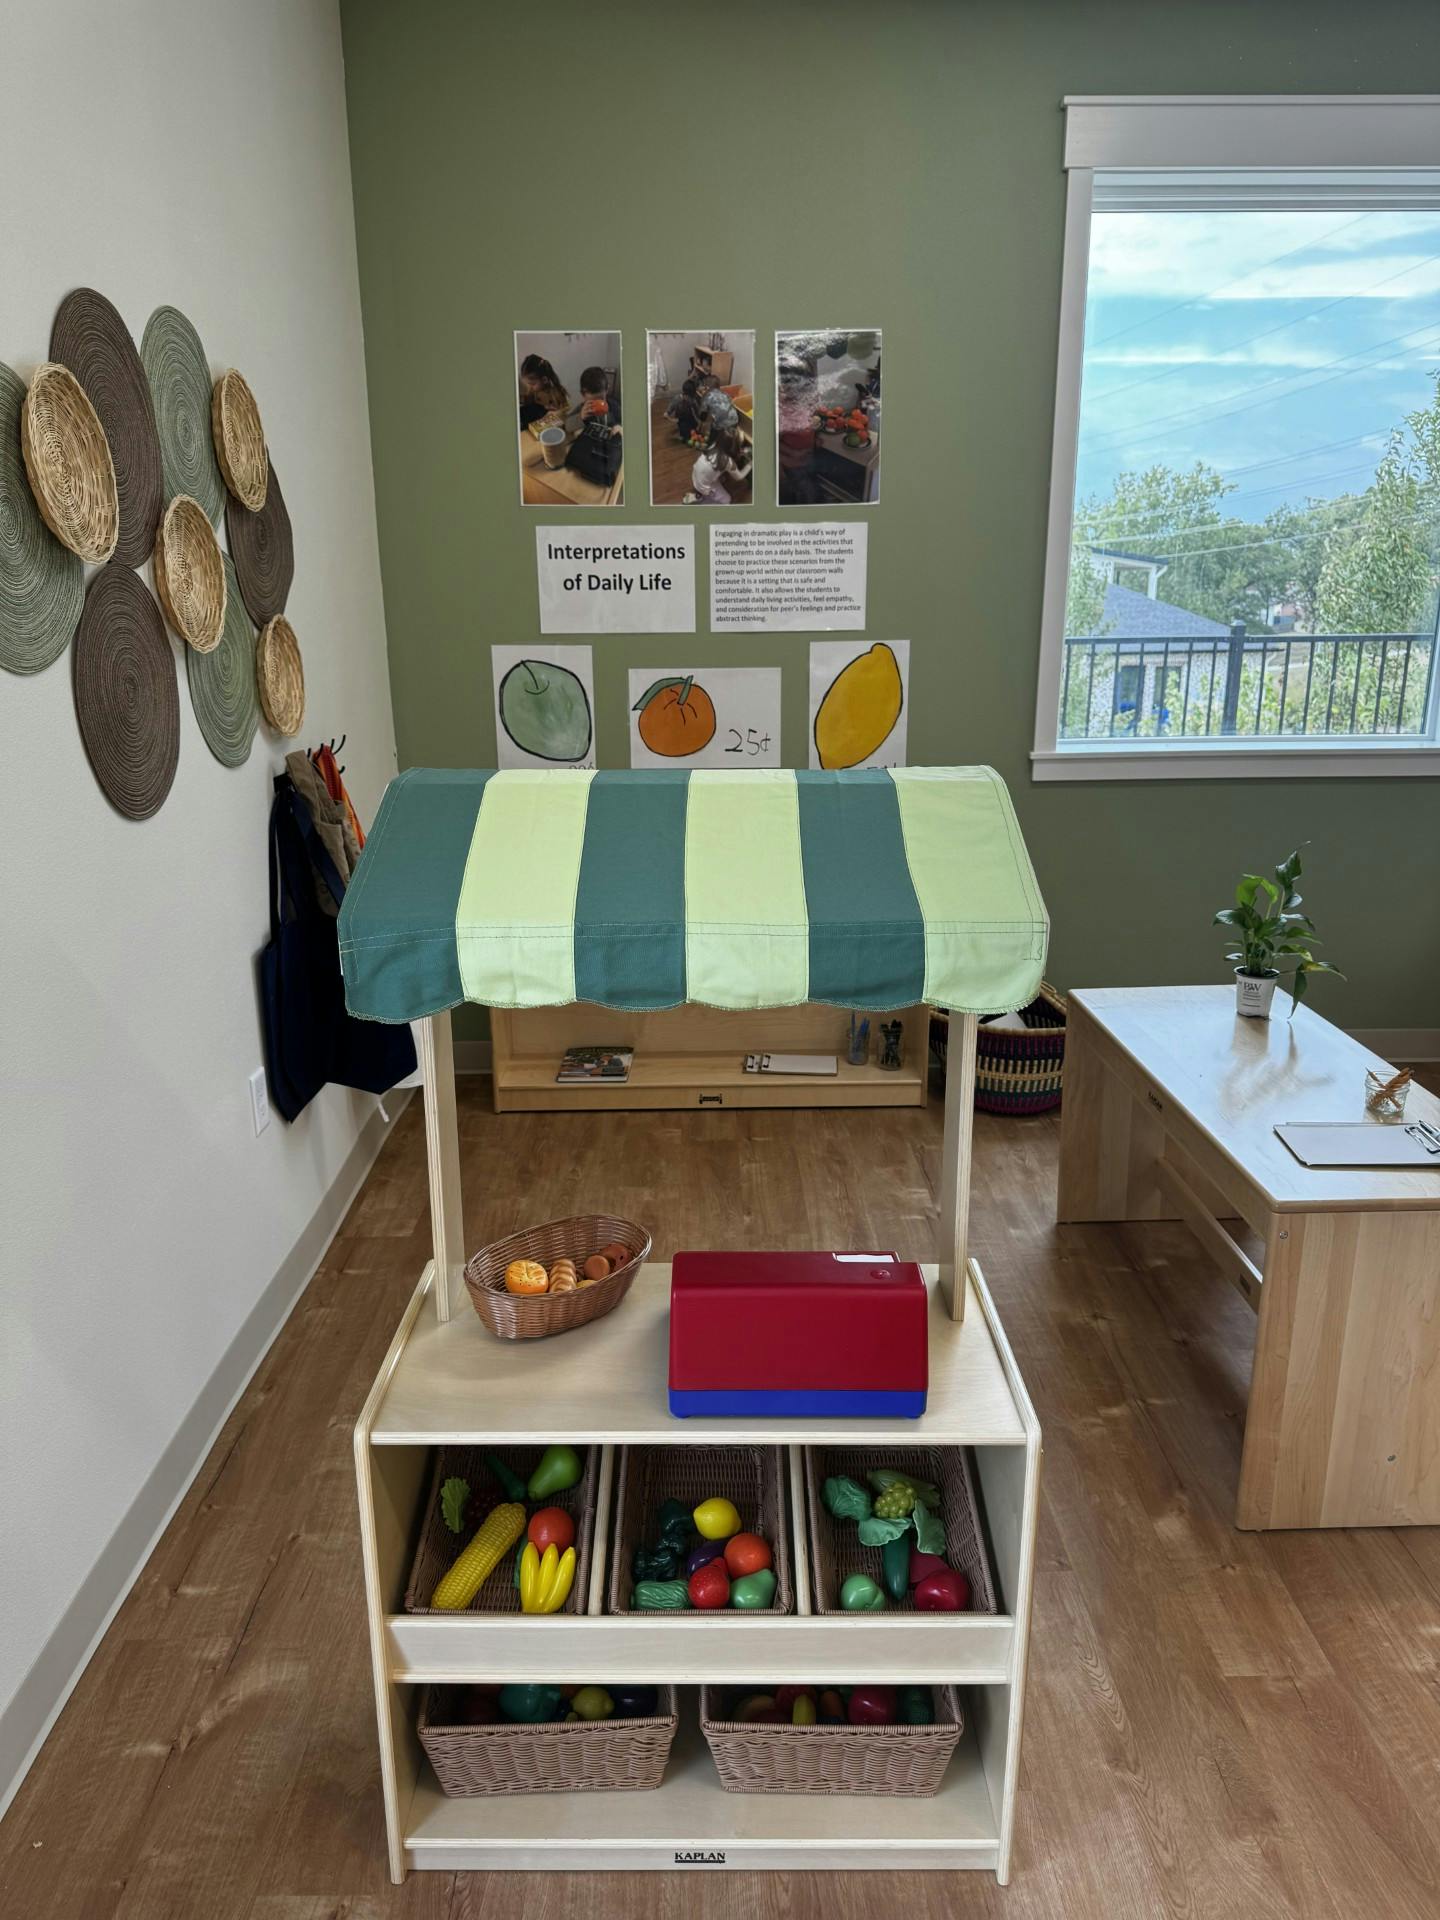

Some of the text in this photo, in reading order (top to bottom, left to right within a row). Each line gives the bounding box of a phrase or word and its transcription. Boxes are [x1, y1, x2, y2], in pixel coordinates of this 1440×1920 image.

[715, 530, 742, 538] Engaging
[779, 529, 791, 538] play
[715, 540, 748, 548] pretending
[548, 543, 685, 563] Interpretations
[731, 549, 754, 557] parents
[779, 548, 793, 556] daily
[746, 558, 770, 566] practice
[563, 574, 671, 594] of Daily Life
[758, 577, 779, 585] setting
[751, 596, 765, 604] daily
[766, 596, 783, 604] living
[826, 595, 854, 604] empathy,
[780, 605, 799, 613] peer's
[800, 605, 823, 613] feelings
[837, 604, 861, 612] practice
[741, 615, 767, 623] thinking.
[725, 729, 770, 756] 25¢
